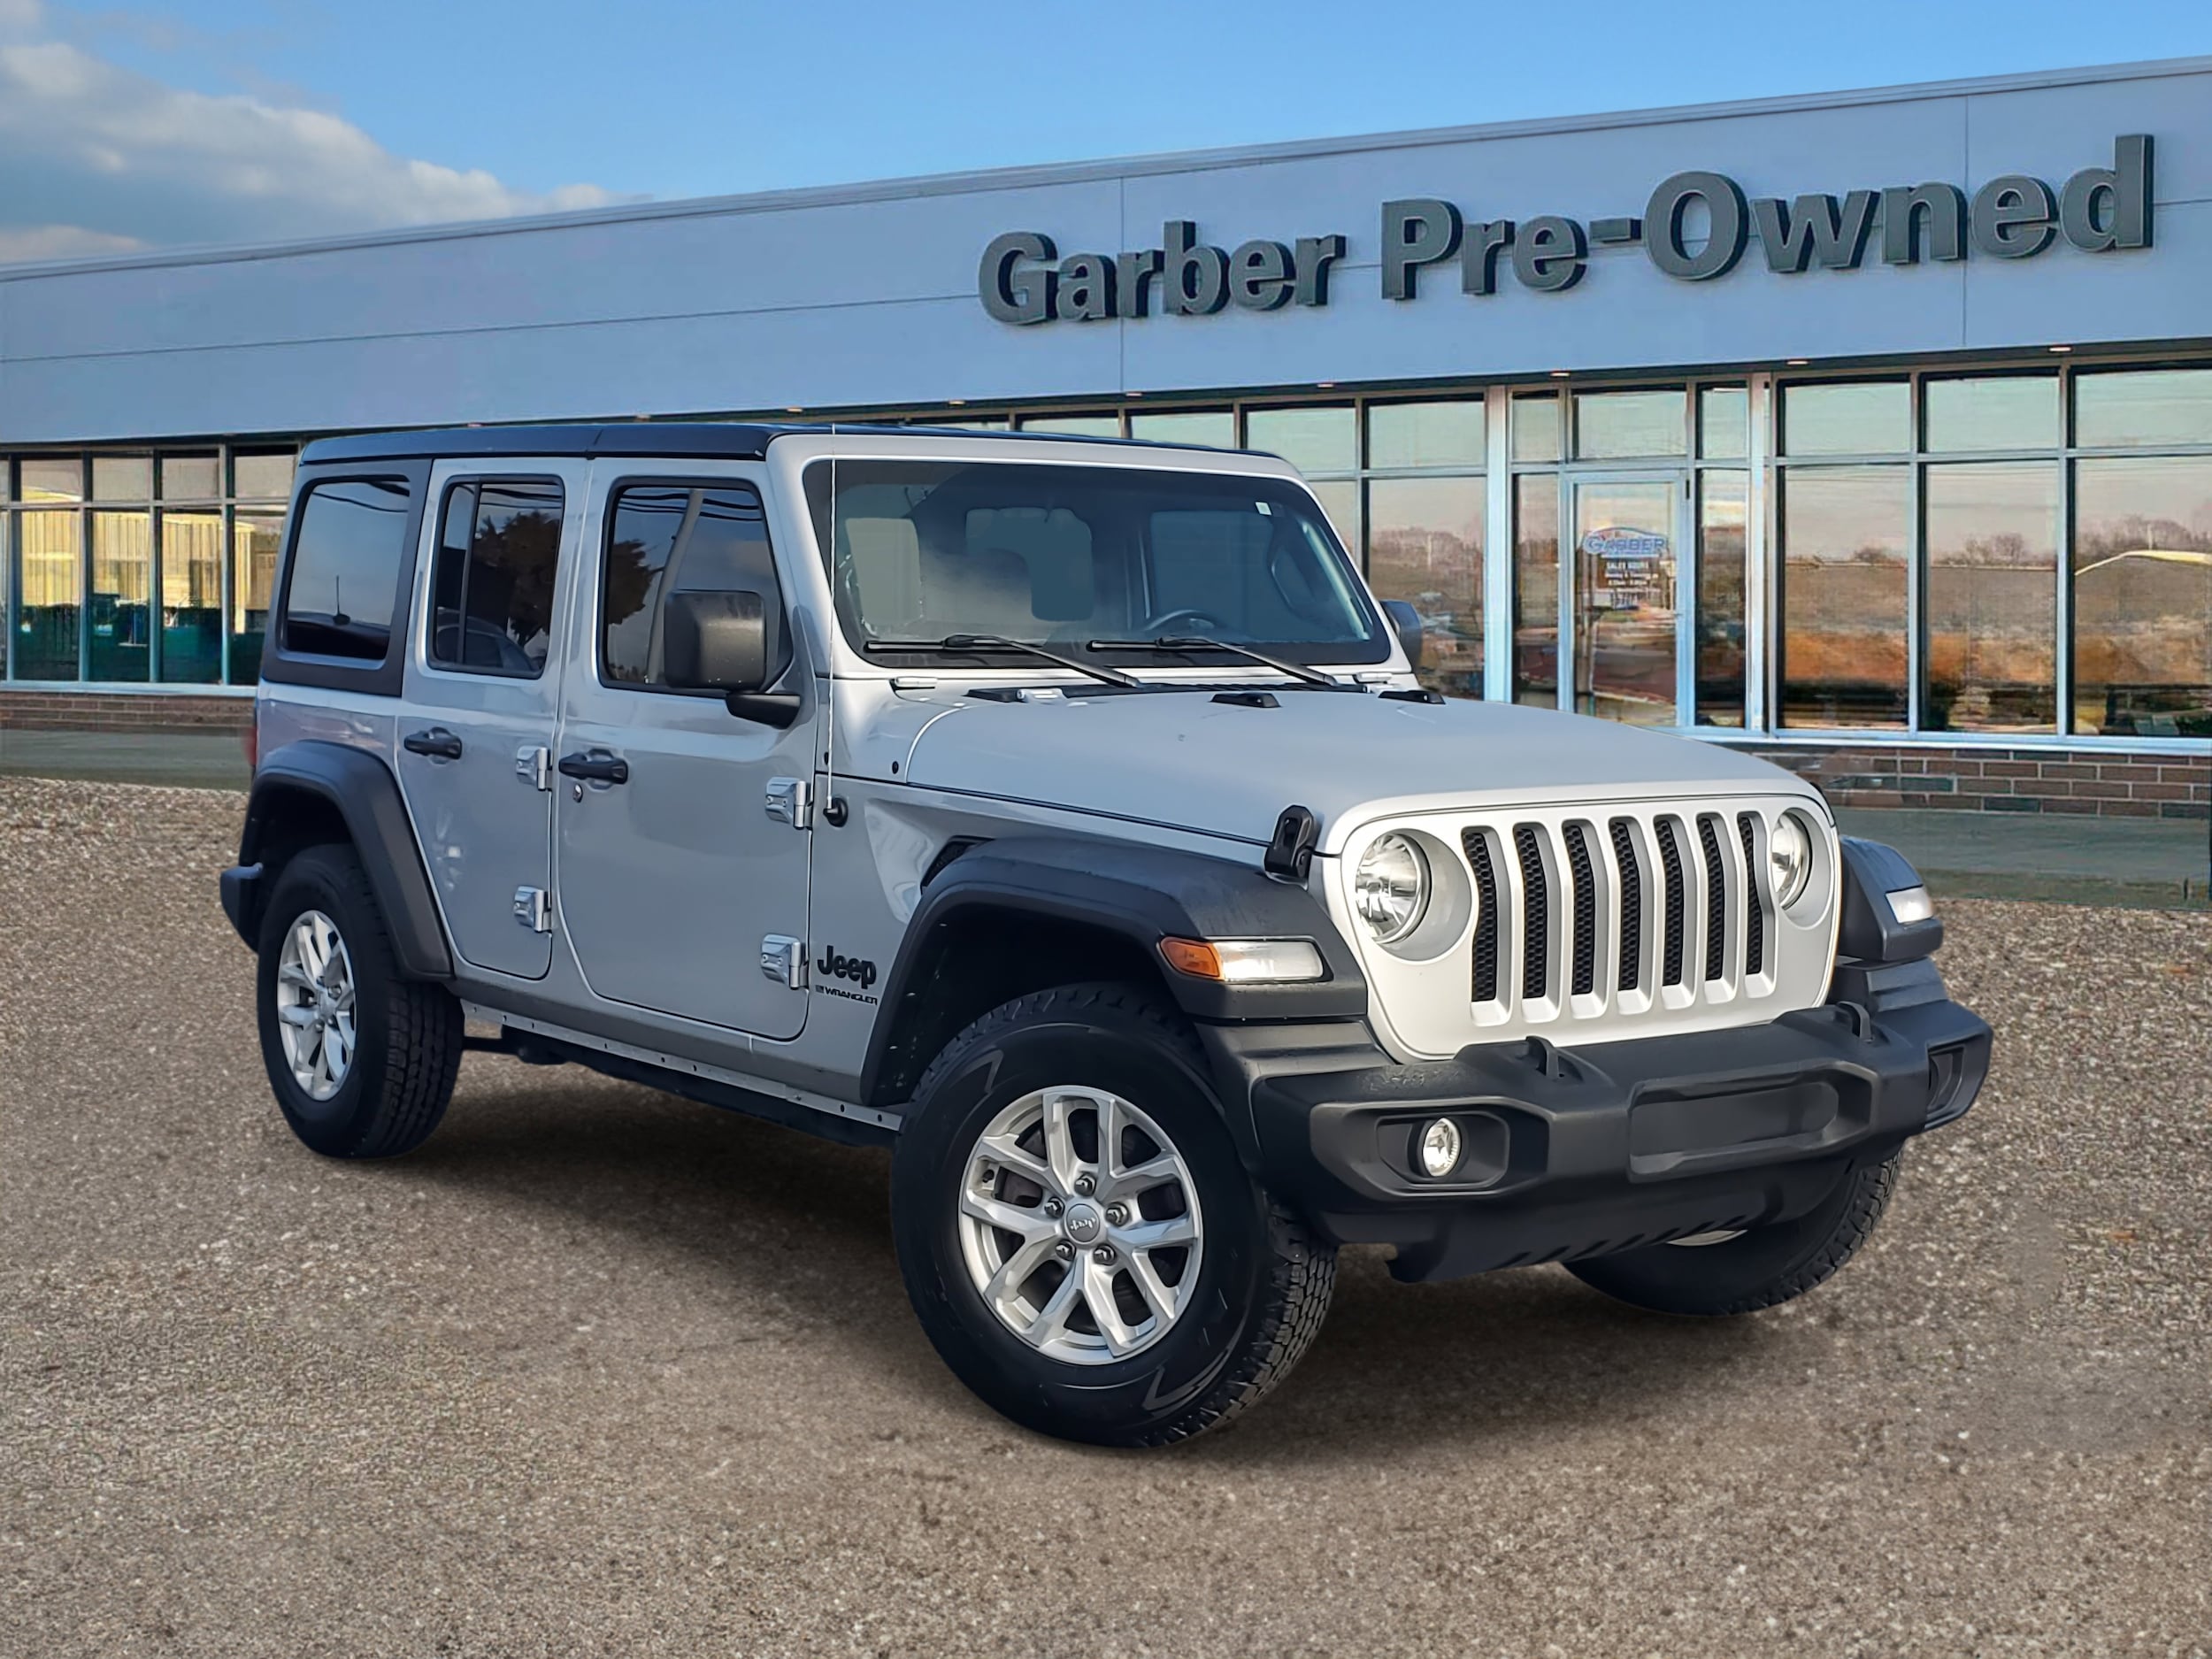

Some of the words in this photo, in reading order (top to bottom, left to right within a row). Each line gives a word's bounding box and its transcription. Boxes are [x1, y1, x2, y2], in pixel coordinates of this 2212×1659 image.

[979, 219, 1347, 326] Garber
[1380, 134, 2154, 301] Pre-Owned
[817, 944, 877, 990] Jeep
